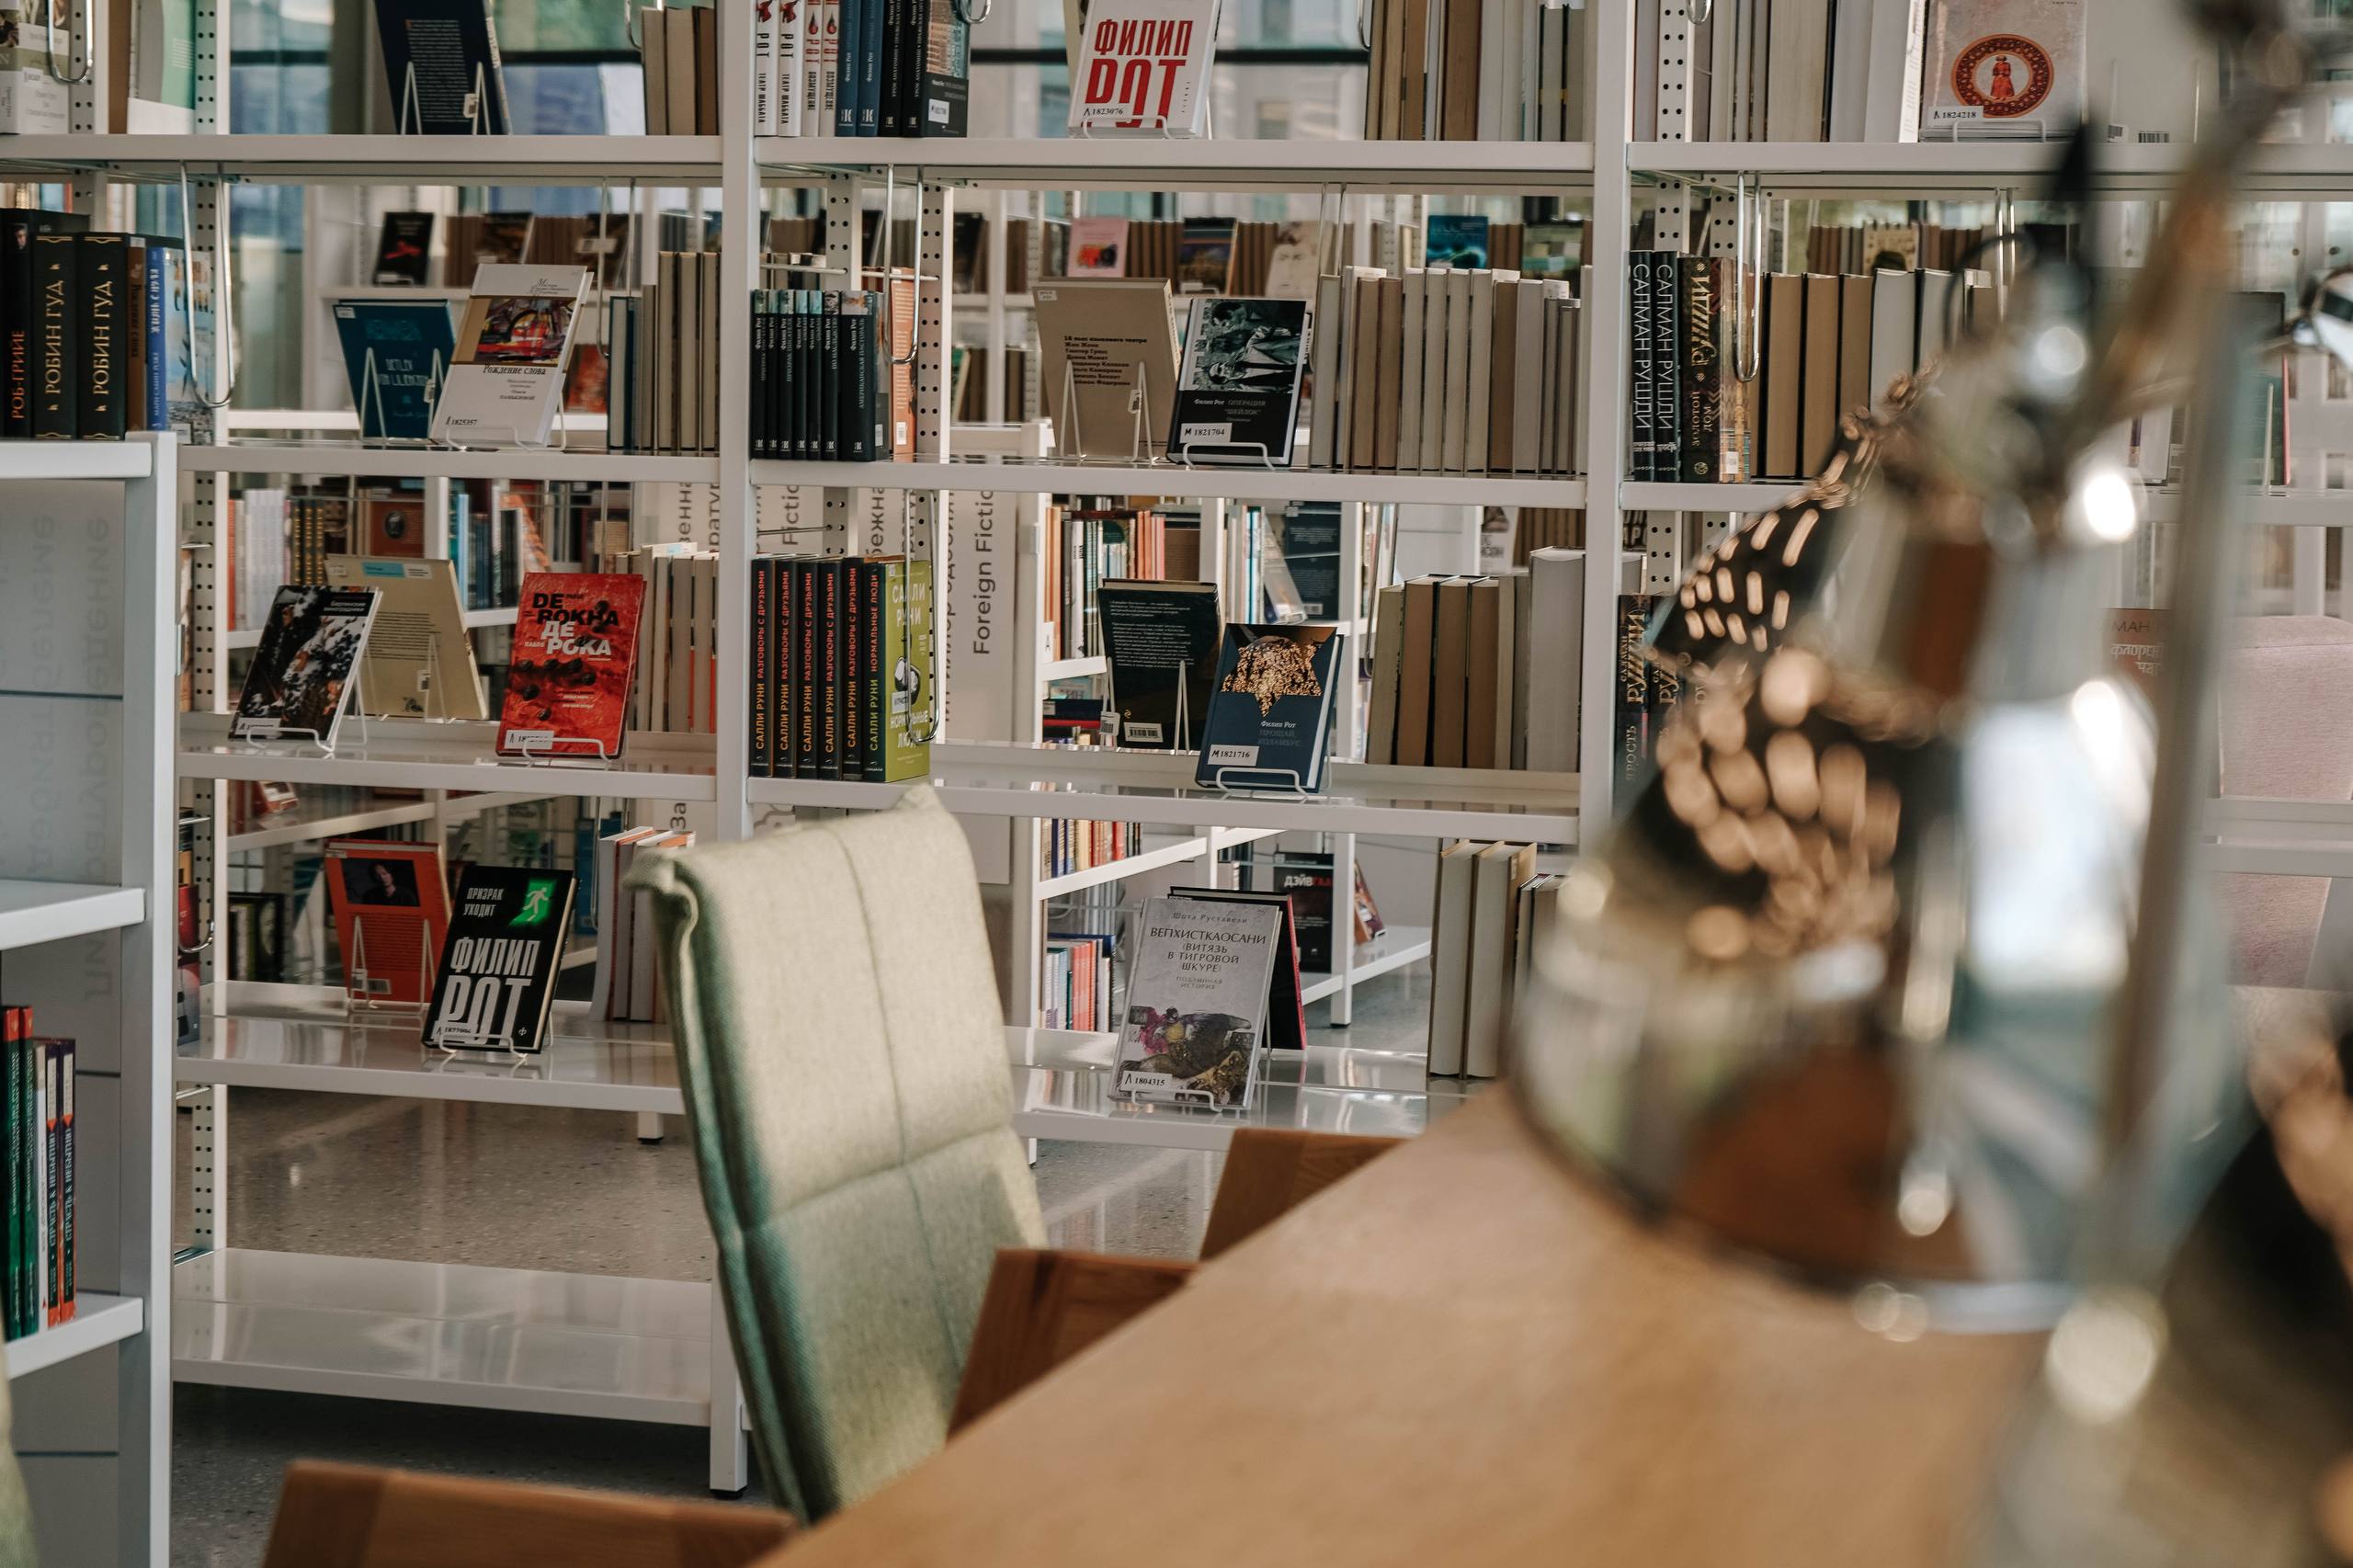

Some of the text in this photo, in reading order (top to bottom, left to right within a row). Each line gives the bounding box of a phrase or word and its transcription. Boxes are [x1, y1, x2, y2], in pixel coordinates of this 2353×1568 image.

[756, 33, 770, 57] РОТ
[780, 33, 794, 58] РОТ
[1095, 19, 1193, 56] ФИЛИП
[805, 39, 820, 63] РОТ
[824, 39, 838, 63] РОТ
[44, 279, 65, 395] РОБИН ГУД
[93, 280, 113, 396] РОБИН ГУД
[1632, 263, 1653, 429] САЛМАН РУШДИ
[1655, 264, 1675, 429] САЛМАН РУШДИ
[11, 330, 26, 419] РОБ-ГРИЙЕ
[532, 593, 565, 608] DE
[973, 562, 996, 654] Foreign
[537, 609, 620, 627] ROKHA
[540, 620, 575, 640] ДЕ
[546, 639, 611, 655] РОКА
[848, 681, 857, 710] РУНИ
[870, 680, 879, 708] РУНИ
[847, 710, 856, 748] САЛЛИ
[870, 711, 879, 750] САЛЛИ
[1284, 873, 1314, 888] ДЭЙВ
[466, 887, 505, 901] ПРИЗРАК
[462, 903, 496, 917] УХОДИТ
[1150, 927, 1266, 945] ВЕПХИСТКАОСАНИ
[449, 936, 541, 976] ФИЛИП
[1167, 951, 1240, 964] В ТИГРОВОЙ
[1134, 1076, 1165, 1086] 1804315
